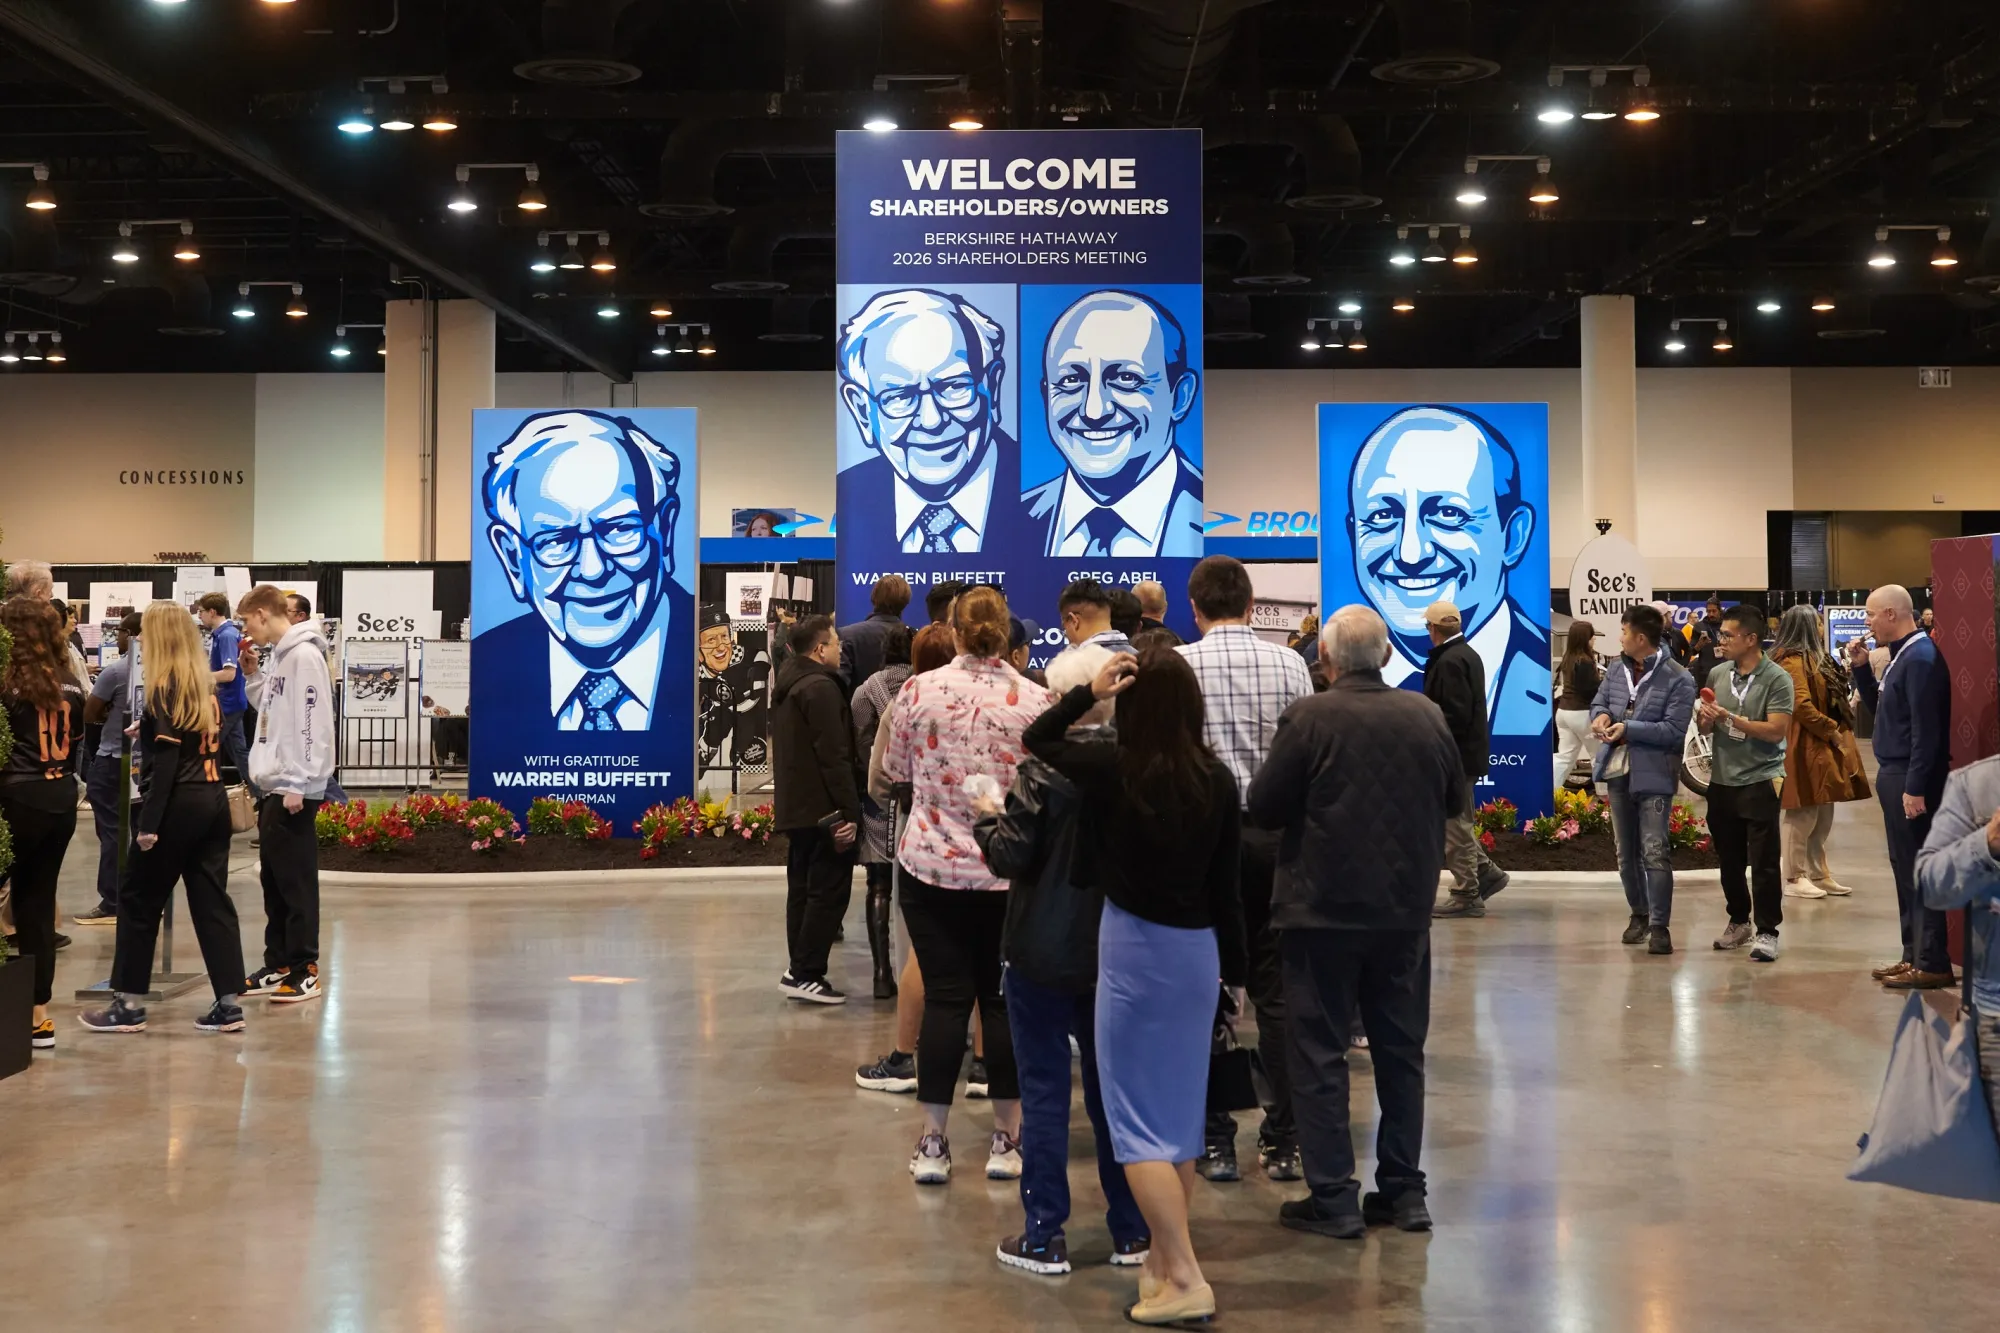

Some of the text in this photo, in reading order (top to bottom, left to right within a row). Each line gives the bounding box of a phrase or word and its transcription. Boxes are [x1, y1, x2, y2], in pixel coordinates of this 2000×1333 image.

[902, 158, 1136, 190] WELCOME
[869, 198, 1169, 218] SHAREHOLDERS/OWNERS
[924, 231, 1118, 246] BERKSHIRE HATHAWAY
[892, 251, 1147, 266] 2026 SHAREHOLDERS MEETING
[119, 470, 244, 485] CONCESSIONS
[1587, 568, 1636, 593] See's
[357, 612, 415, 633] See's
[524, 755, 640, 767] WITH GRATITUDE
[493, 771, 671, 787] WARREN BUFFETT
[887, 799, 896, 853] marimekko
